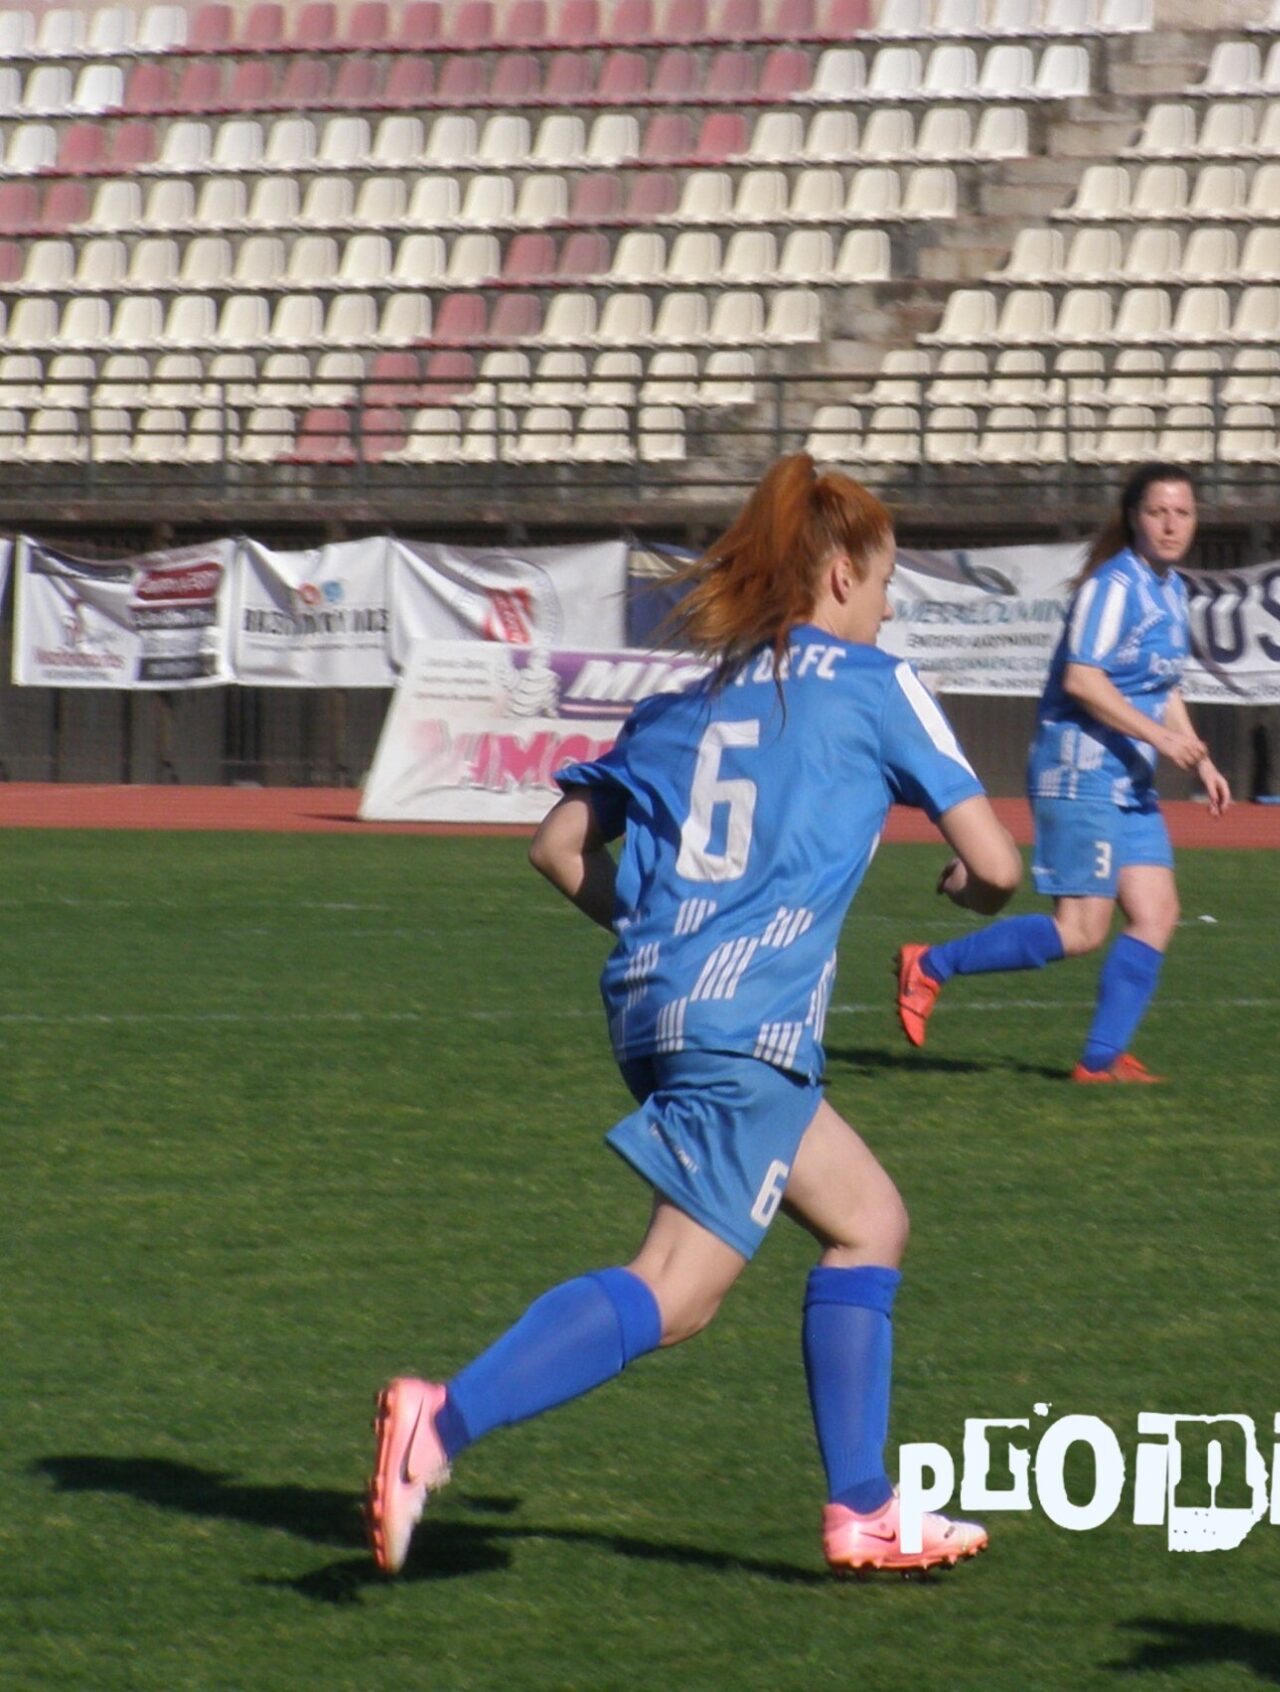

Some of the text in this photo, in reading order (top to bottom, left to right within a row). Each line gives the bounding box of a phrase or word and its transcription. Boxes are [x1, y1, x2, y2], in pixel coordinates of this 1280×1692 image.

[797, 643, 847, 682] FC
[675, 718, 760, 883] 6
[1093, 841, 1112, 879] 3
[750, 1159, 789, 1228] 6
